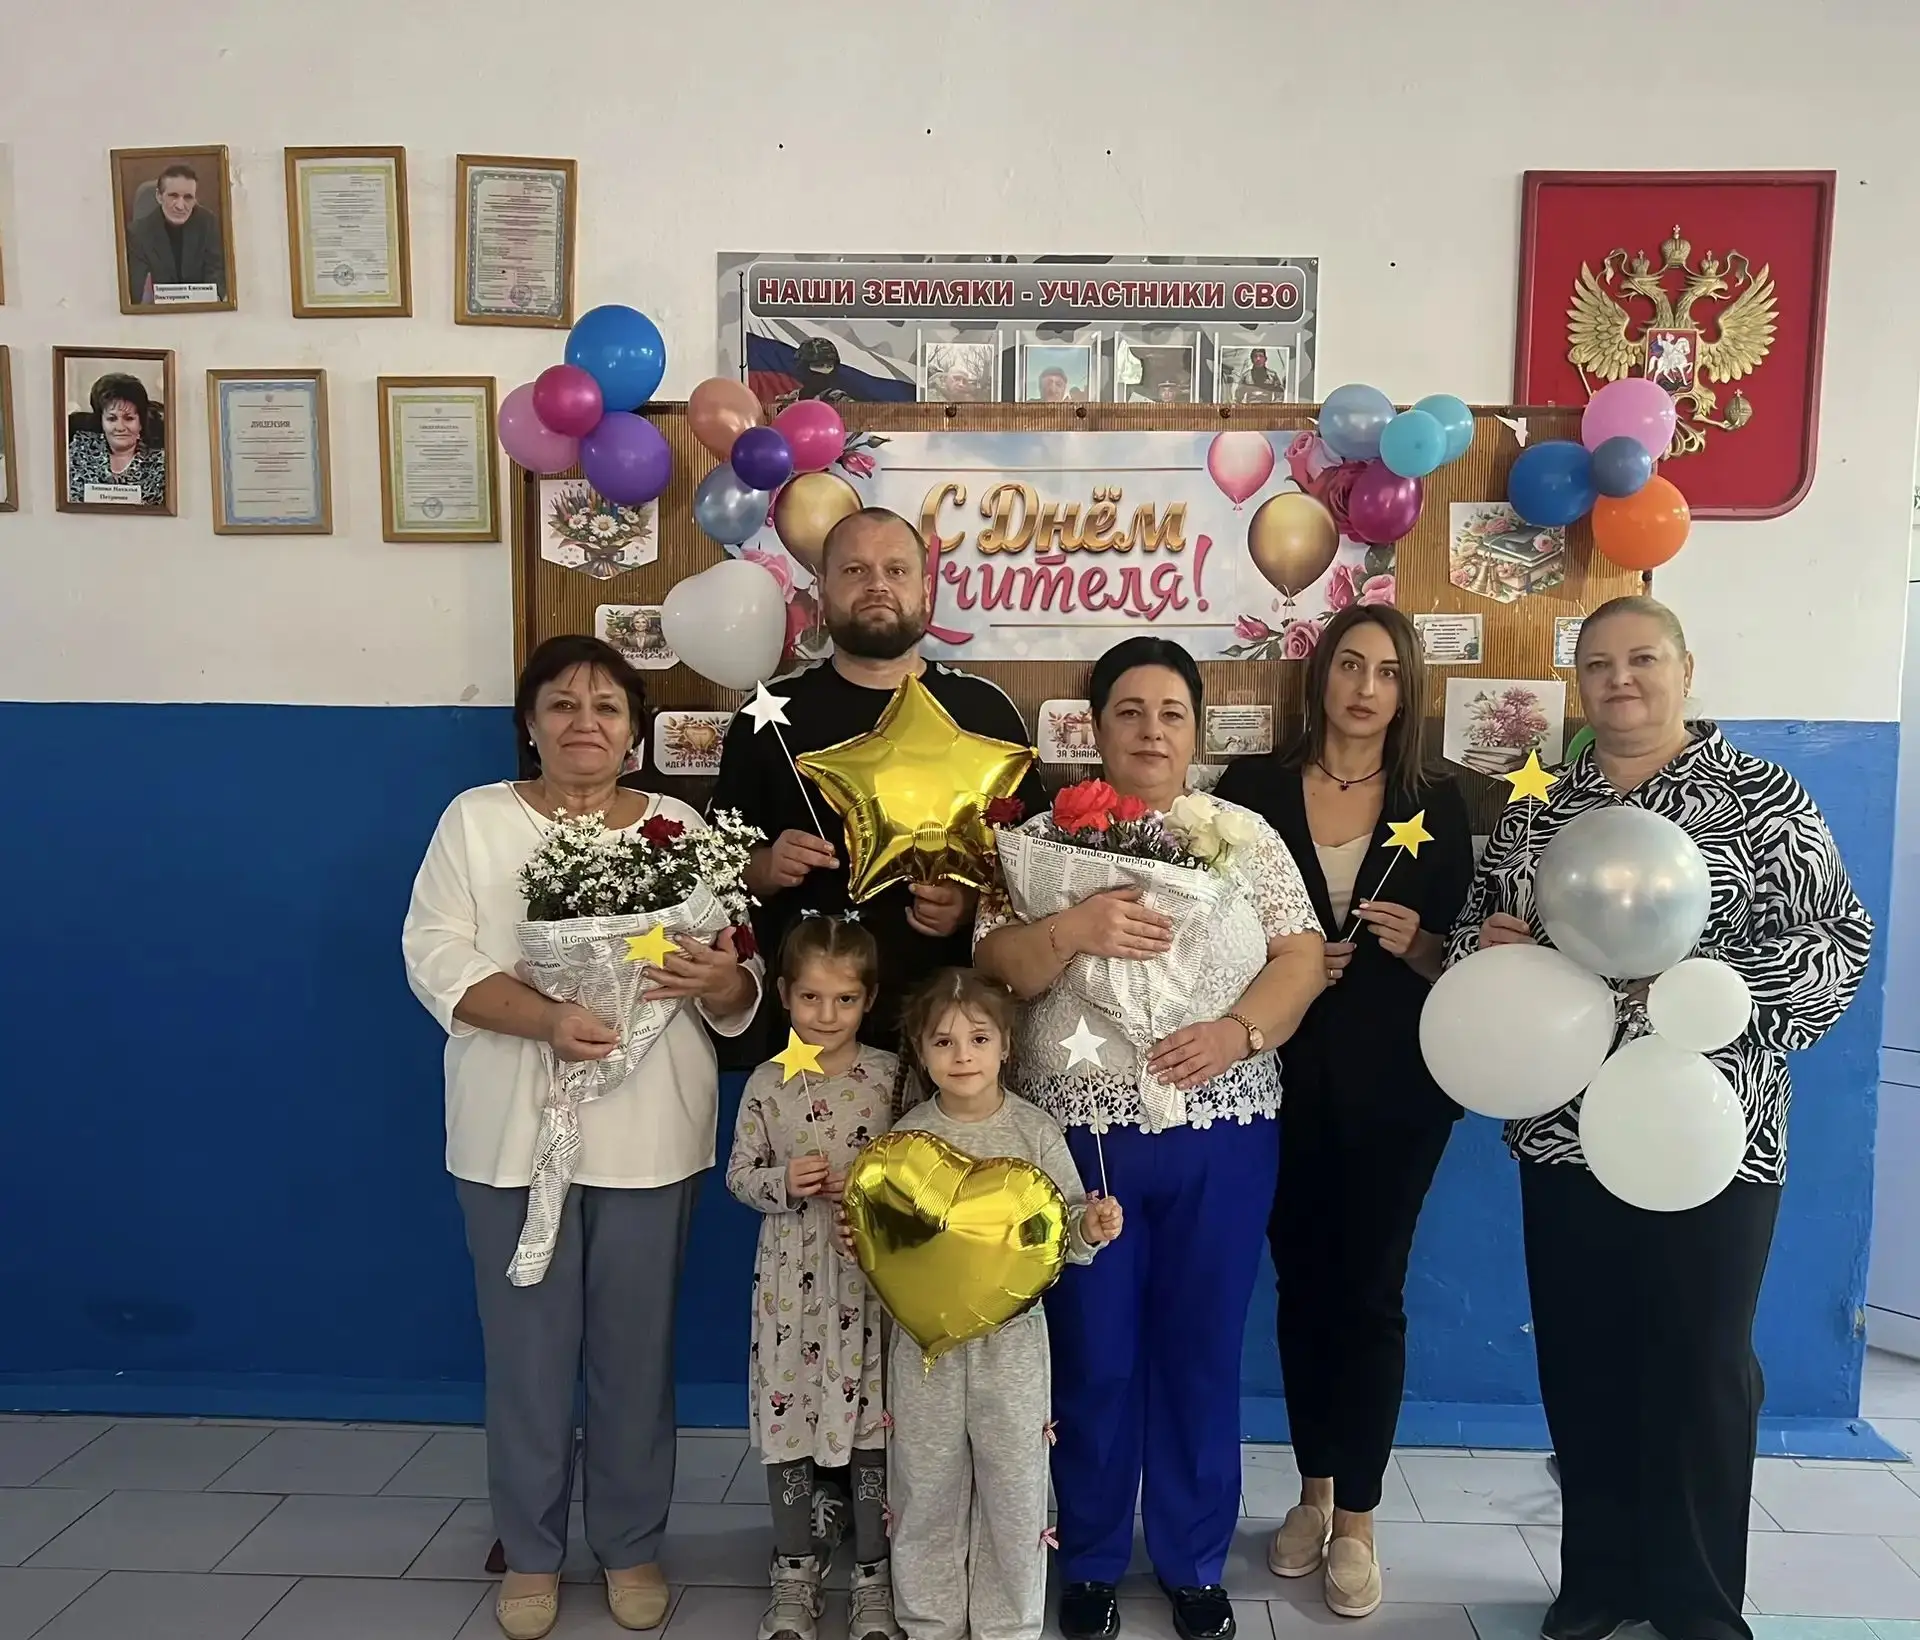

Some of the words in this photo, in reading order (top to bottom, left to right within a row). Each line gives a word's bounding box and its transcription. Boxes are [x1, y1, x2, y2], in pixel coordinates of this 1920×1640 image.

[758, 278, 855, 306] НАШИ
[862, 279, 1015, 307] ЗЕМЛЯКИ
[1040, 281, 1228, 310] УЧАСТНИКИ
[1232, 281, 1298, 310] СВО
[918, 482, 967, 553] С
[977, 482, 1187, 554] Днём
[1056, 750, 1067, 758] ЗА
[1070, 750, 1100, 758] ЗНАНИ
[1116, 855, 1156, 869] Original
